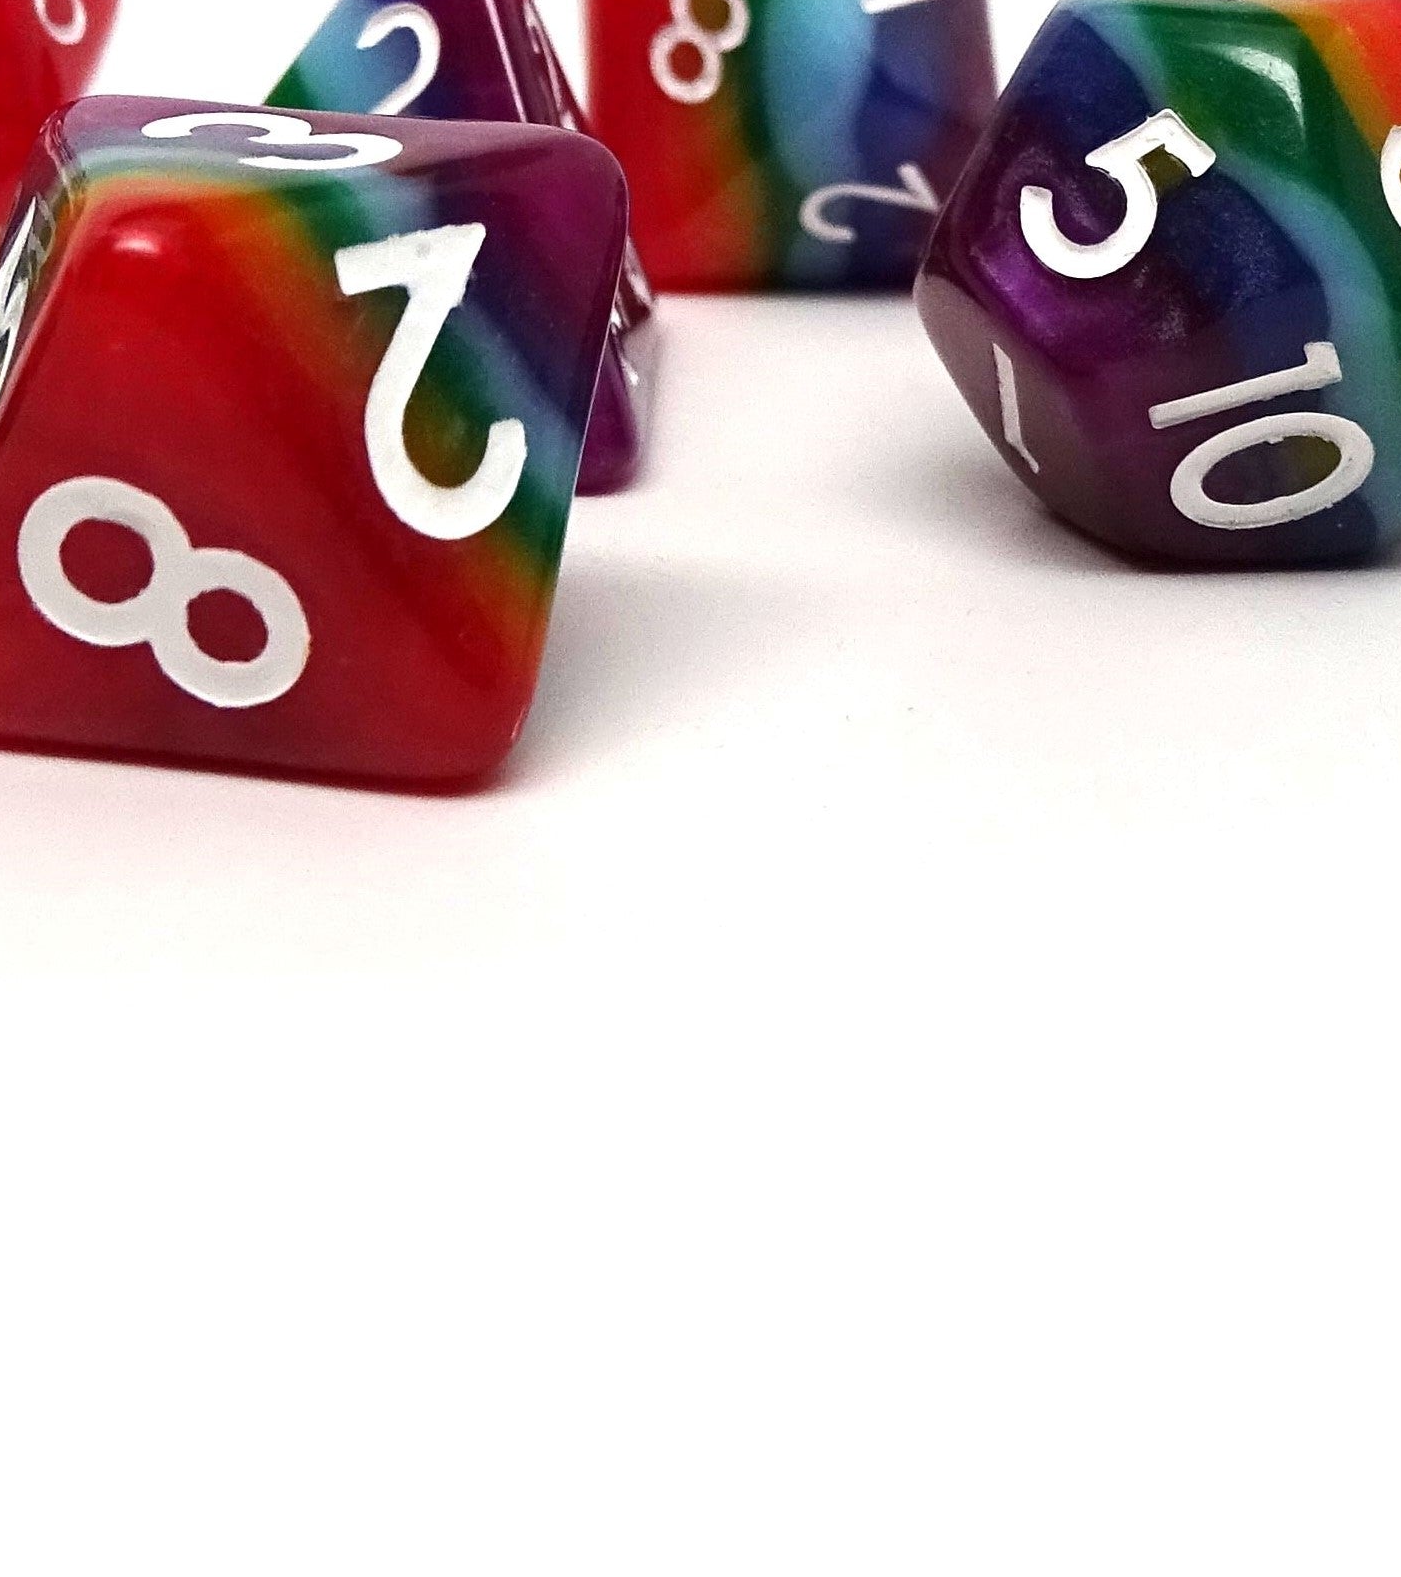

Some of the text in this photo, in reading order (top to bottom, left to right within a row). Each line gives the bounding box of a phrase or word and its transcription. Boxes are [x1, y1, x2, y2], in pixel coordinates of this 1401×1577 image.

[141, 111, 404, 171] 3
[800, 161, 943, 243] 2
[1019, 108, 1216, 279] 5
[334, 222, 529, 541] 2
[1148, 341, 1375, 531] 10
[16, 475, 312, 709] 8
